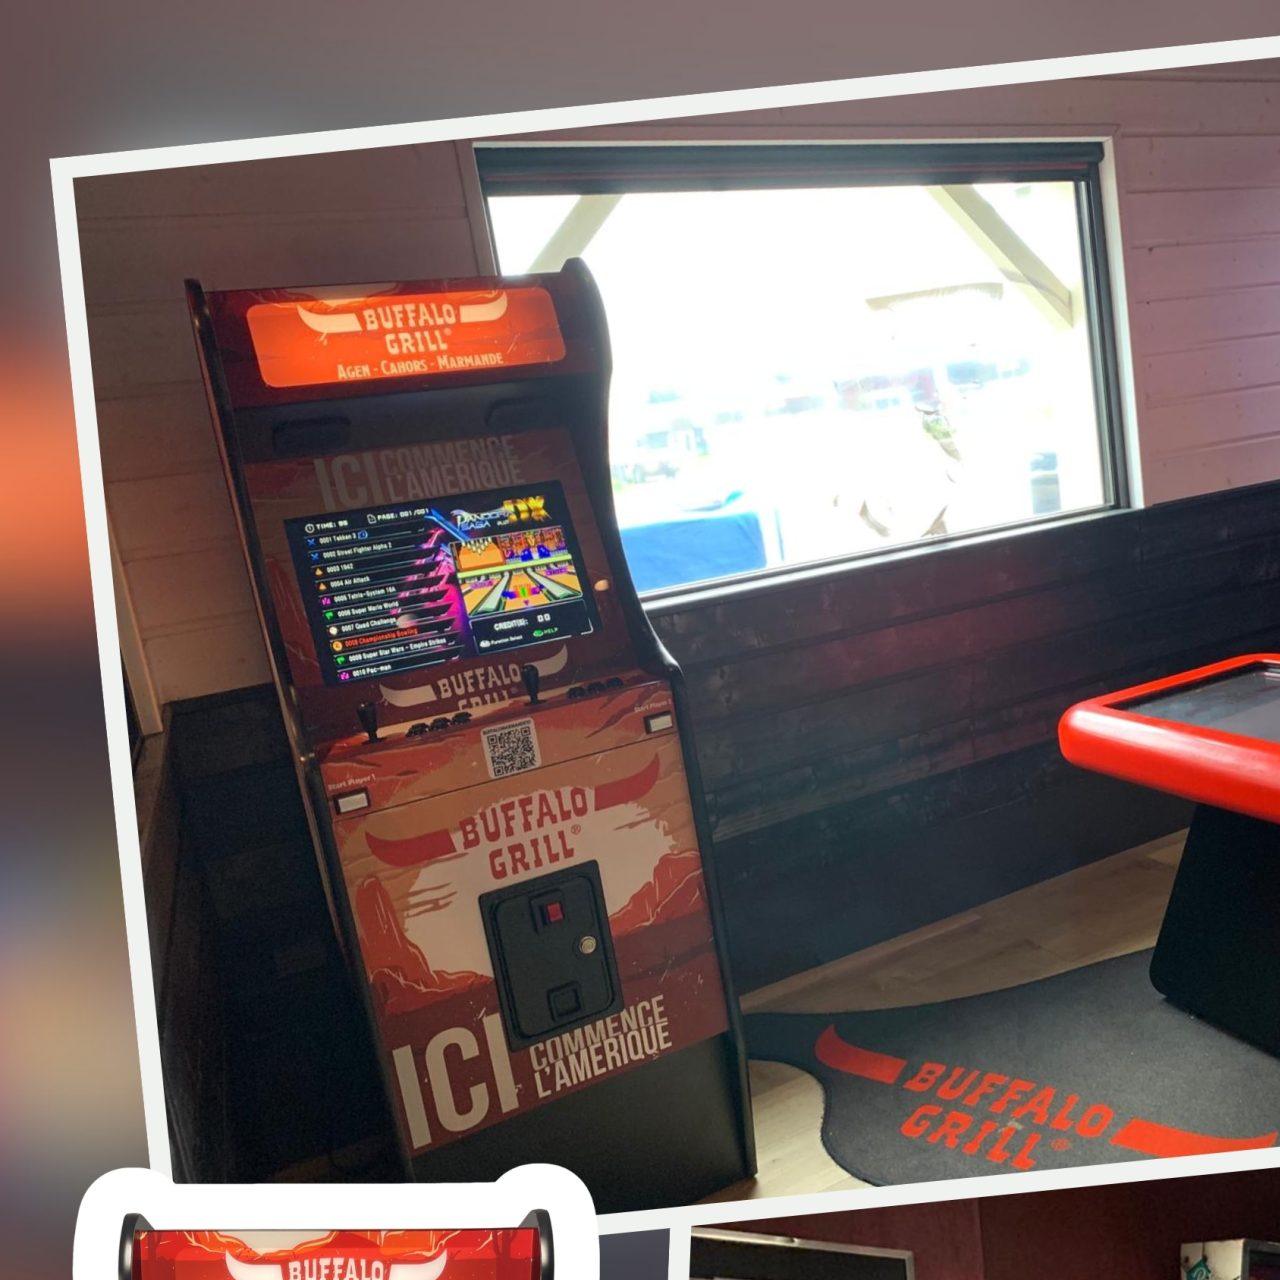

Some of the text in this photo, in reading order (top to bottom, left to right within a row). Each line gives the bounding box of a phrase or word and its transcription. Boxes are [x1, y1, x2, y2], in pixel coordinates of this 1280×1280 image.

[362, 304, 457, 331] BUFFALO
[313, 452, 384, 509] ICI
[382, 435, 515, 478] COMMENCE
[437, 663, 523, 700] BUFFALO
[460, 787, 590, 851] BUFFALO
[529, 994, 668, 1072] COMMENCE
[533, 1020, 673, 1099] L'AMERIQUE
[392, 1012, 520, 1149] ICI
[903, 1061, 1115, 1139] BUFFALO
